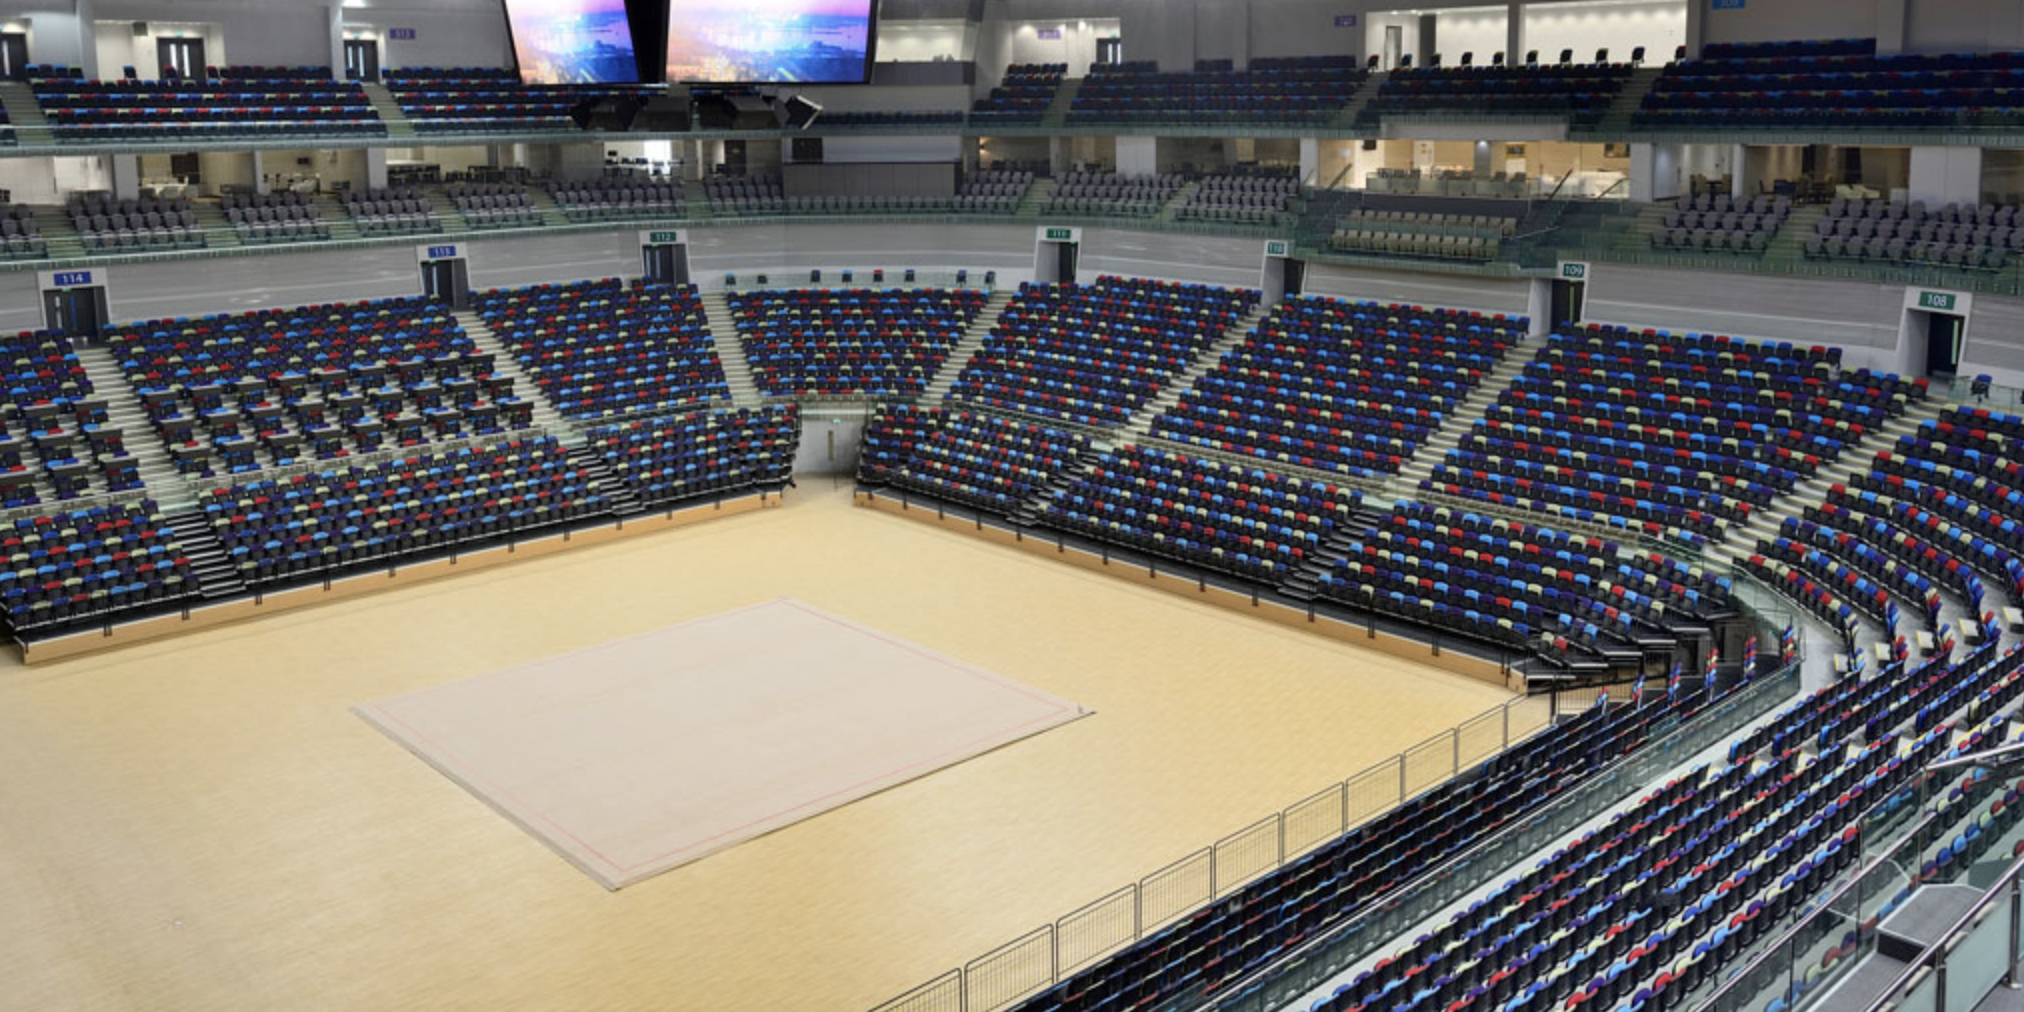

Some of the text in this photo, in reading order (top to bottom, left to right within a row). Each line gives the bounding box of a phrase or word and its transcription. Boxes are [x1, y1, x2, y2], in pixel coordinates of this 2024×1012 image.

[1565, 265, 1583, 276] 109
[62, 273, 84, 284] 114
[1927, 293, 1947, 307] 108
